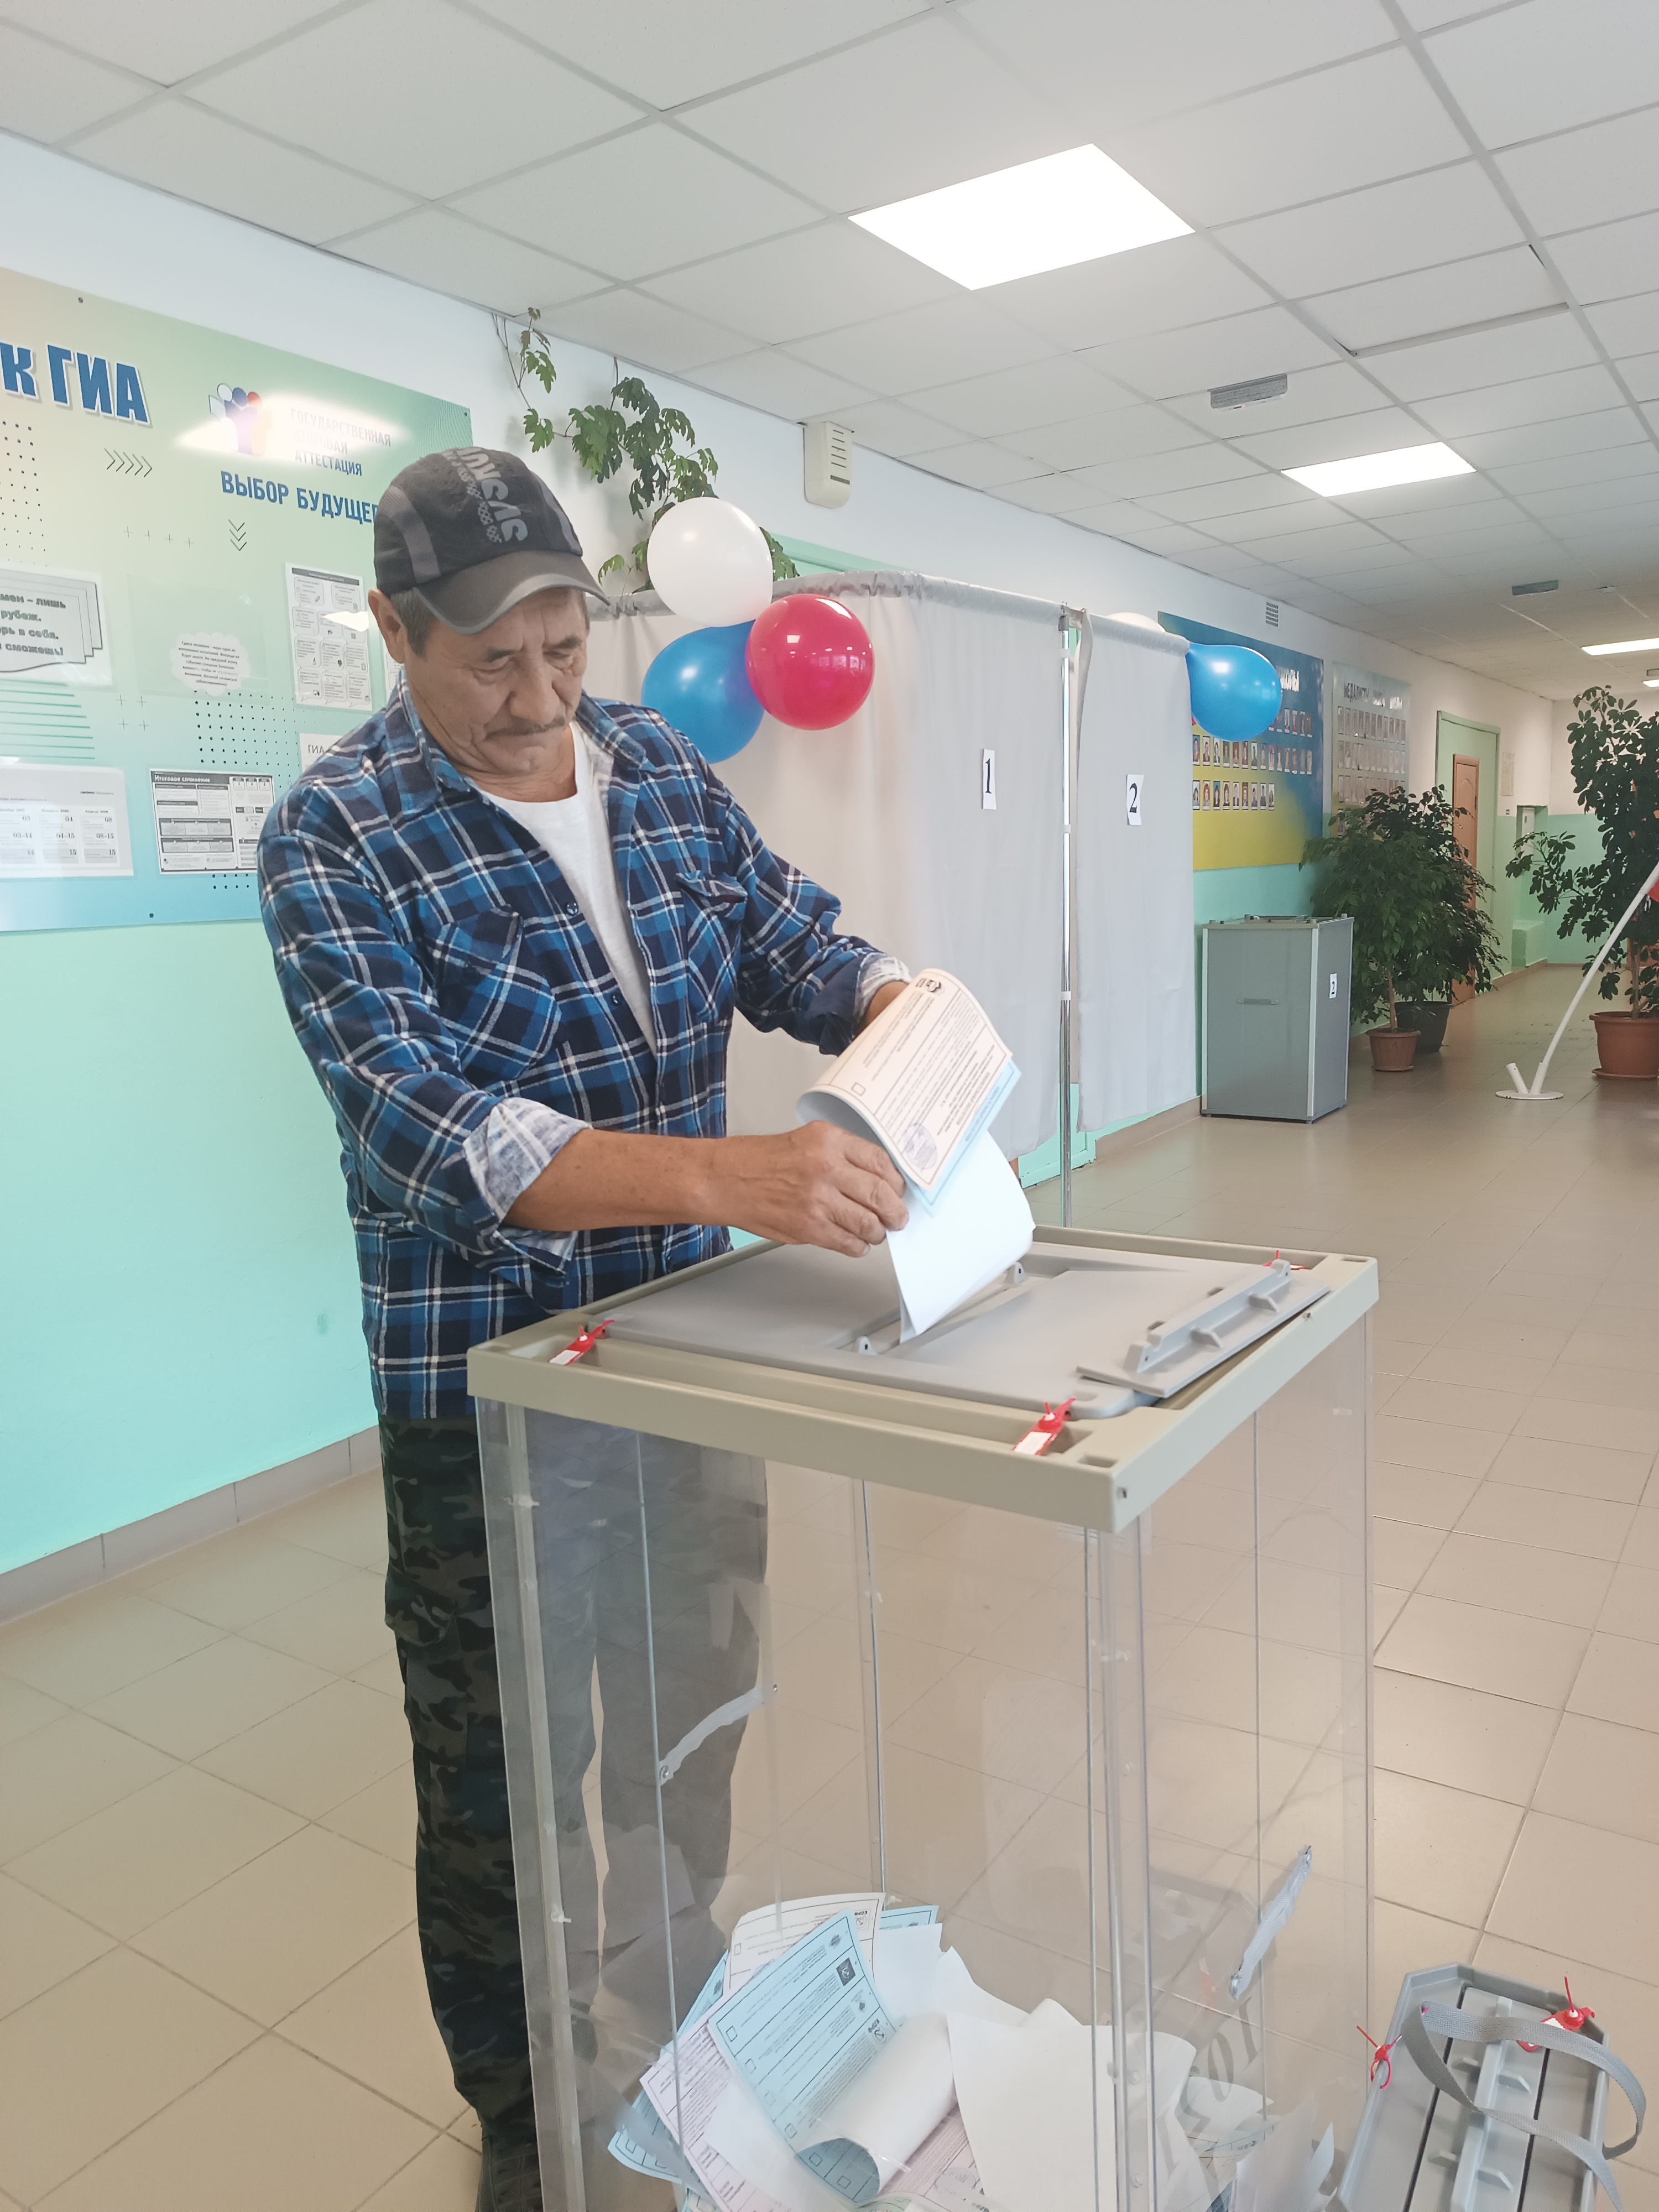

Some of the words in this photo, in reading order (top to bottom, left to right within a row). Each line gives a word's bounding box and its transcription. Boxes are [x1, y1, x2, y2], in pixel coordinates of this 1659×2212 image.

[0, 342, 37, 397] К
[47, 344, 149, 424] ГИА
[291, 408, 391, 447] ГОСУДАРСТВЕННАЯ
[295, 450, 362, 476] АТТЕСТАЦИЯ
[221, 471, 289, 504] ВЫБОР
[36, 598, 66, 608] лишь
[985, 758, 992, 794] 1
[1129, 782, 1138, 813] 2
